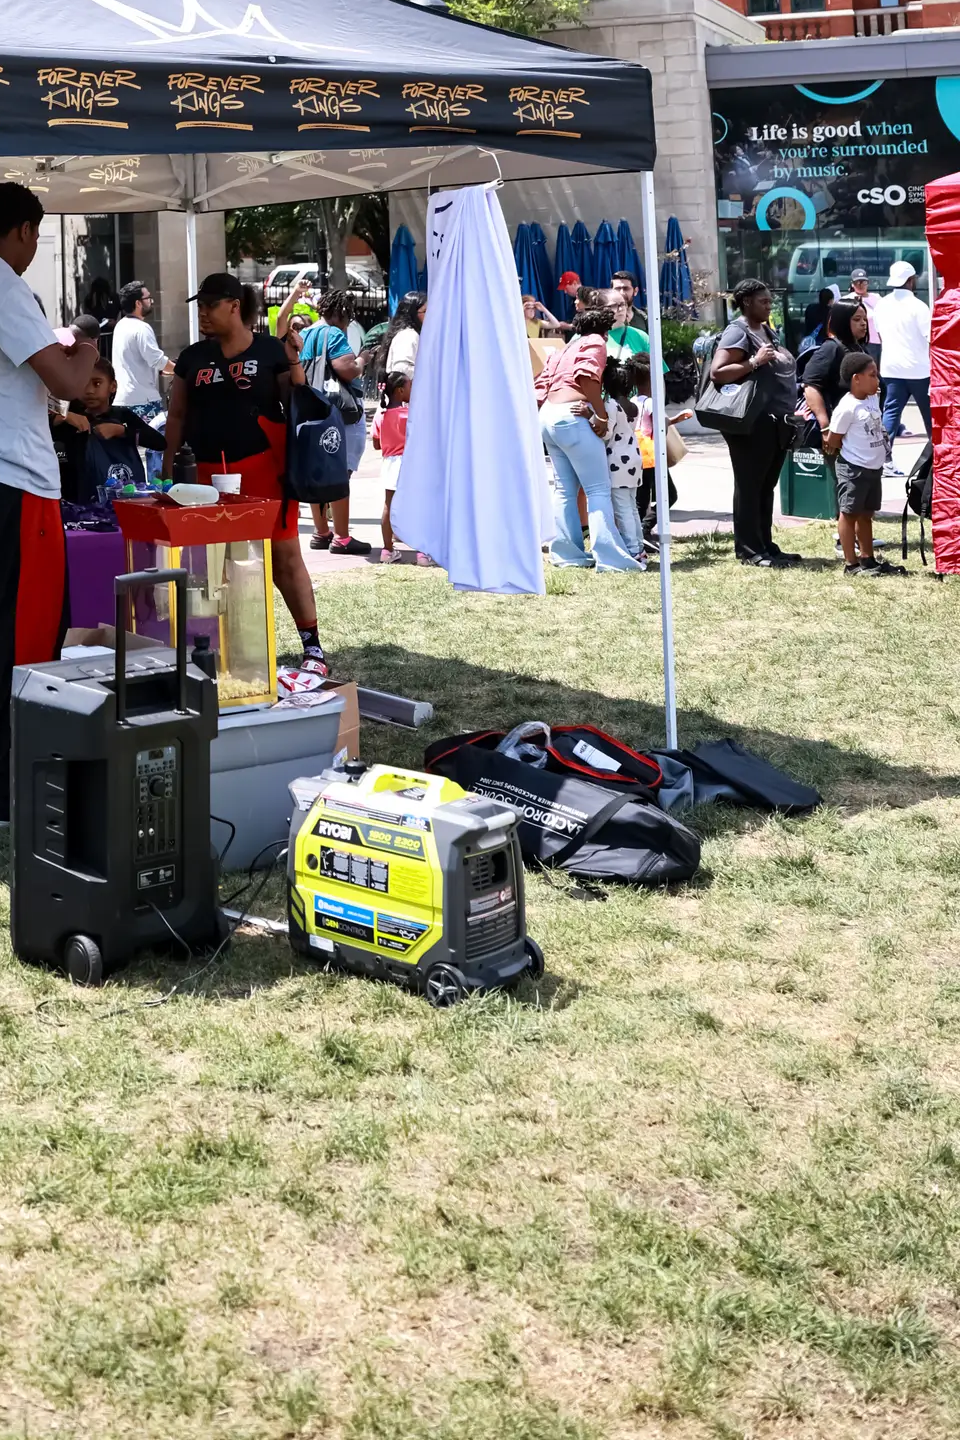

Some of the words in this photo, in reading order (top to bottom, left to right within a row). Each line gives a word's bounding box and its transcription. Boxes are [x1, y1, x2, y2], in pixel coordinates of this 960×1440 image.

[37, 67, 141, 91] FOREVER
[167, 72, 265, 94] FOREVER
[289, 78, 380, 98] FOREVER
[40, 86, 119, 115] KINGS
[401, 82, 488, 103] FOREVER
[508, 86, 590, 106] FOREVER
[170, 91, 244, 118] KINGS
[292, 95, 362, 121] KINGS
[405, 99, 471, 124] KINGS
[512, 103, 575, 127] KINGS
[751, 125, 788, 141] Life
[792, 123, 808, 139] is
[812, 121, 862, 143] good
[866, 121, 913, 136] when
[779, 144, 828, 160] you're
[832, 139, 928, 157] surrounded
[774, 165, 793, 182] by
[797, 162, 849, 178] music.
[504, 782, 537, 801] BACKDROPS
[537, 797, 561, 811] PREMIER
[319, 820, 352, 840] RYOBI
